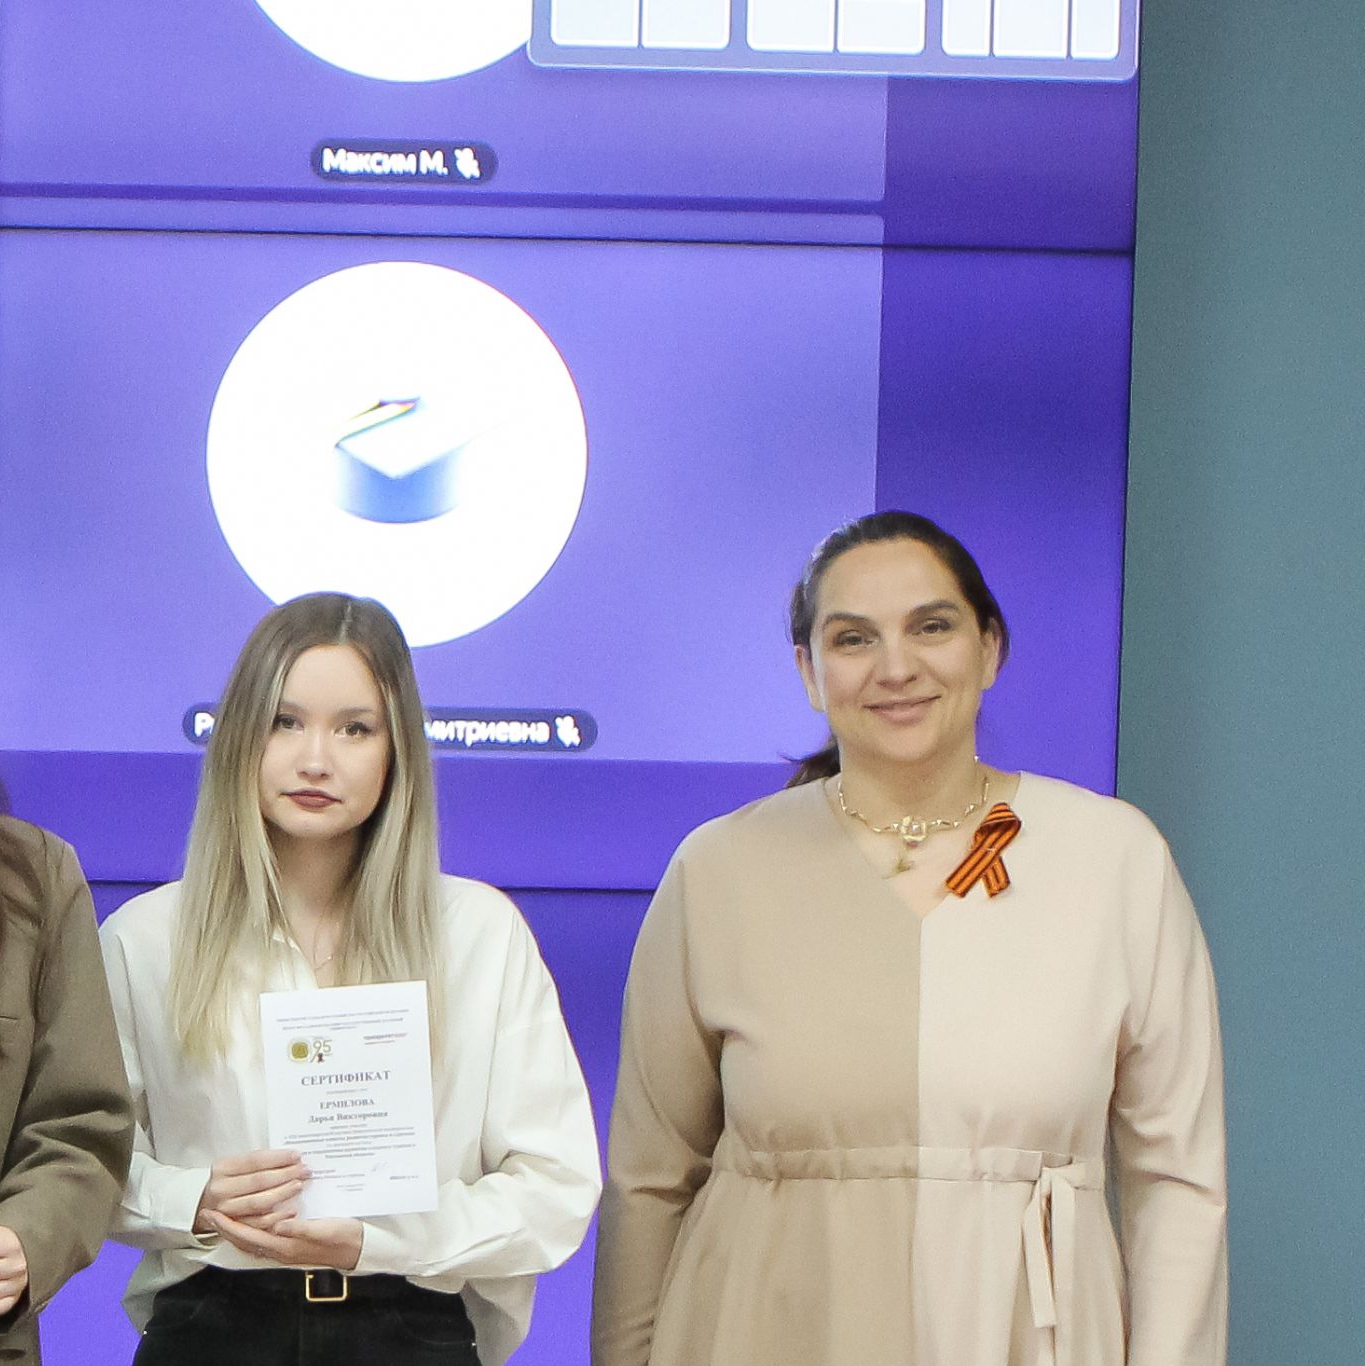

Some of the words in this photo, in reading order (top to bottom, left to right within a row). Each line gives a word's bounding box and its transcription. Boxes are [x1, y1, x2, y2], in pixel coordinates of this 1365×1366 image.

[322, 147, 418, 175] Максим
[419, 149, 449, 176] М.
[301, 1070, 391, 1086] СЕРТИФИКАТ
